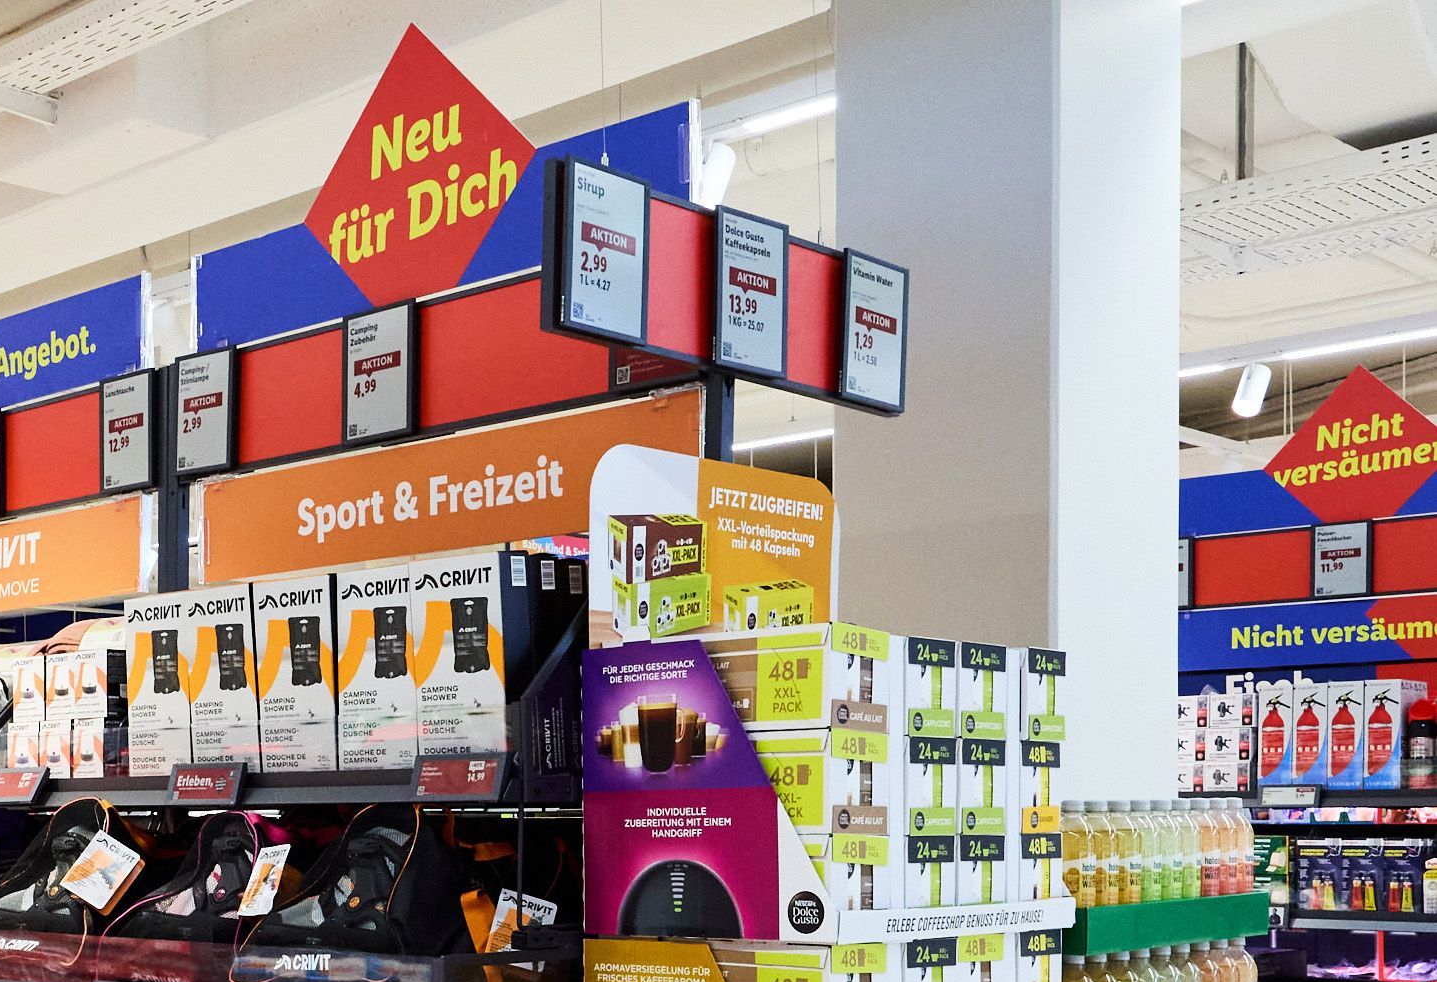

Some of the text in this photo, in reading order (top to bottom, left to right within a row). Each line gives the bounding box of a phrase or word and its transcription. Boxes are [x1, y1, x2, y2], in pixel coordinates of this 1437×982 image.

[370, 104, 462, 180] Neu
[577, 177, 605, 198] Sirup
[329, 150, 517, 268] für Dich
[591, 228, 628, 249] AKTION
[725, 224, 764, 244] Dolce Gusto
[725, 237, 771, 259] Kaffeekapseln
[581, 251, 607, 273] 2.99
[580, 274, 584, 285] 1
[586, 275, 590, 286] L
[597, 280, 611, 291] 4.27
[737, 271, 769, 290] AKTION
[853, 267, 892, 287] Vitamin Water
[729, 294, 757, 315] 13.99
[728, 315, 732, 325] 1
[733, 316, 742, 328] KG
[862, 311, 890, 328] AKTION
[350, 322, 378, 336] Camping
[350, 333, 376, 347] Zubehör
[855, 332, 873, 350] 1.29
[361, 355, 393, 370] AKTION
[354, 379, 376, 398] 4.99
[190, 395, 216, 407] AKTION
[114, 416, 138, 428] AKTION
[183, 417, 202, 433] 2.99
[1316, 413, 1404, 452] Nicht
[109, 436, 130, 453] 12.99
[297, 455, 563, 544] Sport & Freizeit
[709, 487, 823, 521] JETZT ZUGREIFEN!
[718, 517, 814, 547] XXL-Vorteilspackung
[522, 540, 543, 551] Baby,
[545, 541, 564, 554] Kind
[672, 547, 696, 563] XXL-PACK
[732, 537, 800, 557] mit 48 Kapseln
[1321, 562, 1343, 572] 11.99
[440, 567, 492, 587] CRIVIT
[0, 578, 40, 596] MOVE
[842, 632, 858, 649] 48
[1231, 624, 1304, 649] Nicht
[917, 644, 930, 661] 24
[602, 659, 694, 675] FÜR JEDEN GESCHMACK
[769, 659, 794, 681] 48
[609, 670, 687, 684] DIE RICHTIGE SORTE
[421, 685, 459, 693] CAMPING
[421, 693, 457, 702] SHOWER
[774, 687, 801, 699] XXL-
[773, 701, 802, 713] PACK
[422, 719, 463, 727] CAMPING-
[870, 714, 883, 723] LAIT
[422, 727, 456, 735] DUSCHE
[177, 775, 213, 788] Erleben,
[647, 807, 707, 817] INDIVIDUELLE
[624, 817, 731, 828] ZUBEREITUNG MIT EINEM
[652, 829, 702, 838] HANDGRIFF
[521, 899, 553, 916] CRIVIT
[792, 905, 819, 919] Dolce
[792, 913, 819, 925] Gusto
[886, 909, 1044, 933] ERLEBE COFFEESHOP GENUSS FÜR ZU HAUSE!
[293, 954, 331, 971] CRIVIT
[594, 963, 710, 976] AROMAVERSIEGELUNG FÜR
[597, 973, 638, 982] FRISCHES
